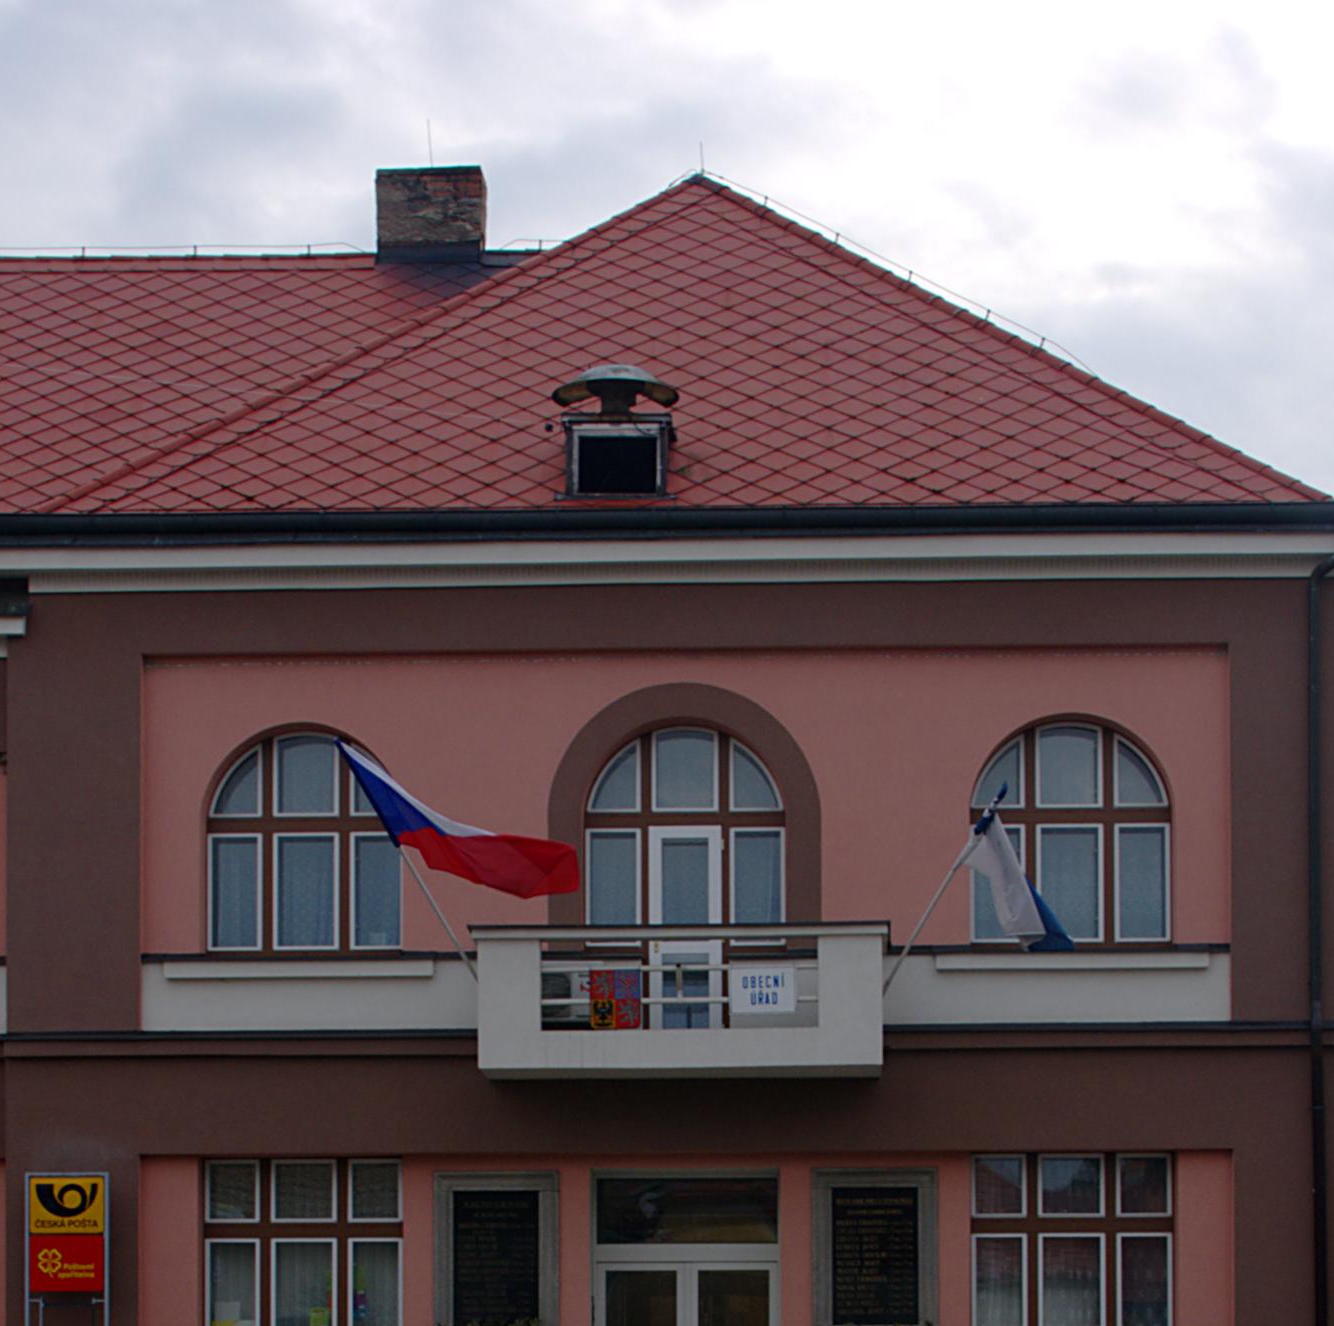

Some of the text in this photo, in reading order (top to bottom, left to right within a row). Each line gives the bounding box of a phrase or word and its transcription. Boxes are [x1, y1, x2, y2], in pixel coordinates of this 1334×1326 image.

[742, 971, 785, 989] OBECNÍ
[750, 989, 778, 1006] ÚŘAD
[35, 1217, 99, 1229] ČESKÁ POŠTA
